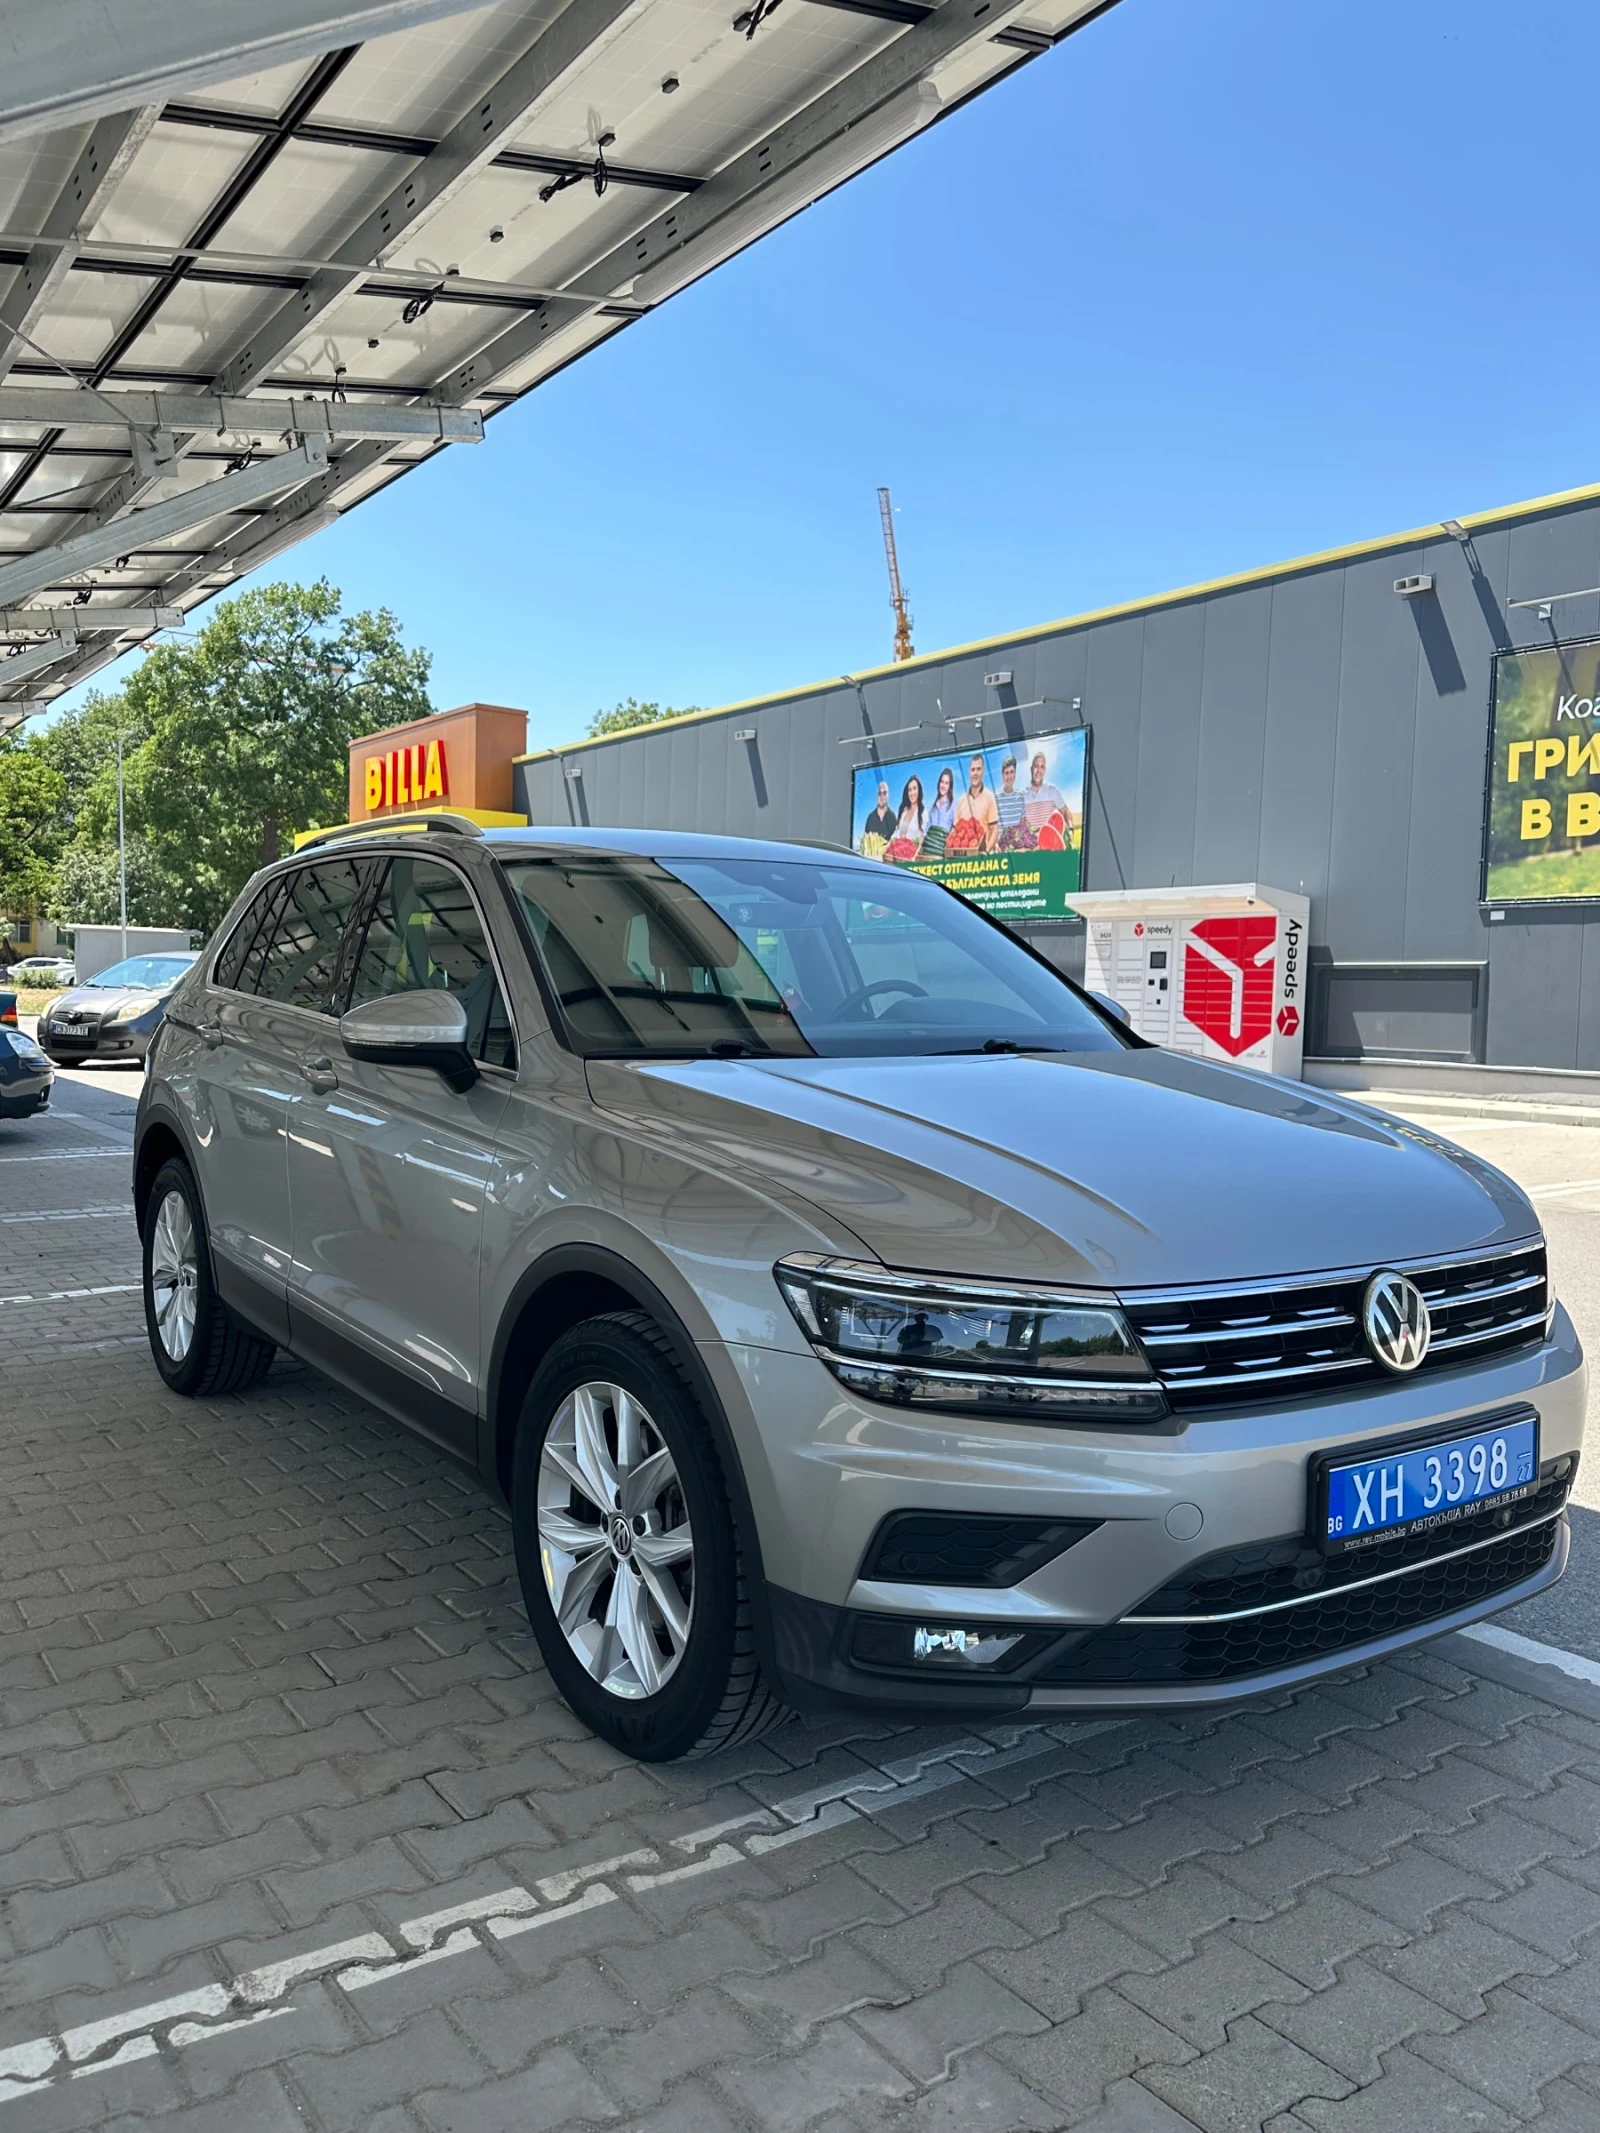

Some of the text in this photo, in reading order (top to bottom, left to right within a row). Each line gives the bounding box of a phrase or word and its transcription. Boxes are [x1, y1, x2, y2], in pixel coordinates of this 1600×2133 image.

[365, 739, 449, 811] BILLA
[1520, 798, 1553, 841] В
[944, 860, 999, 875] ОТГЛЕДАНА
[1001, 858, 1009, 870] С
[946, 874, 1011, 890] БЪЛГАРСКАТА
[1012, 872, 1041, 885] ЗЕМЯ
[1147, 925, 1173, 936] speedy
[1284, 918, 1303, 999] speedy
[1423, 1438, 1508, 1509] 3398
[1464, 1501, 1482, 1517] RAY
[1328, 1515, 1343, 1534] BG
